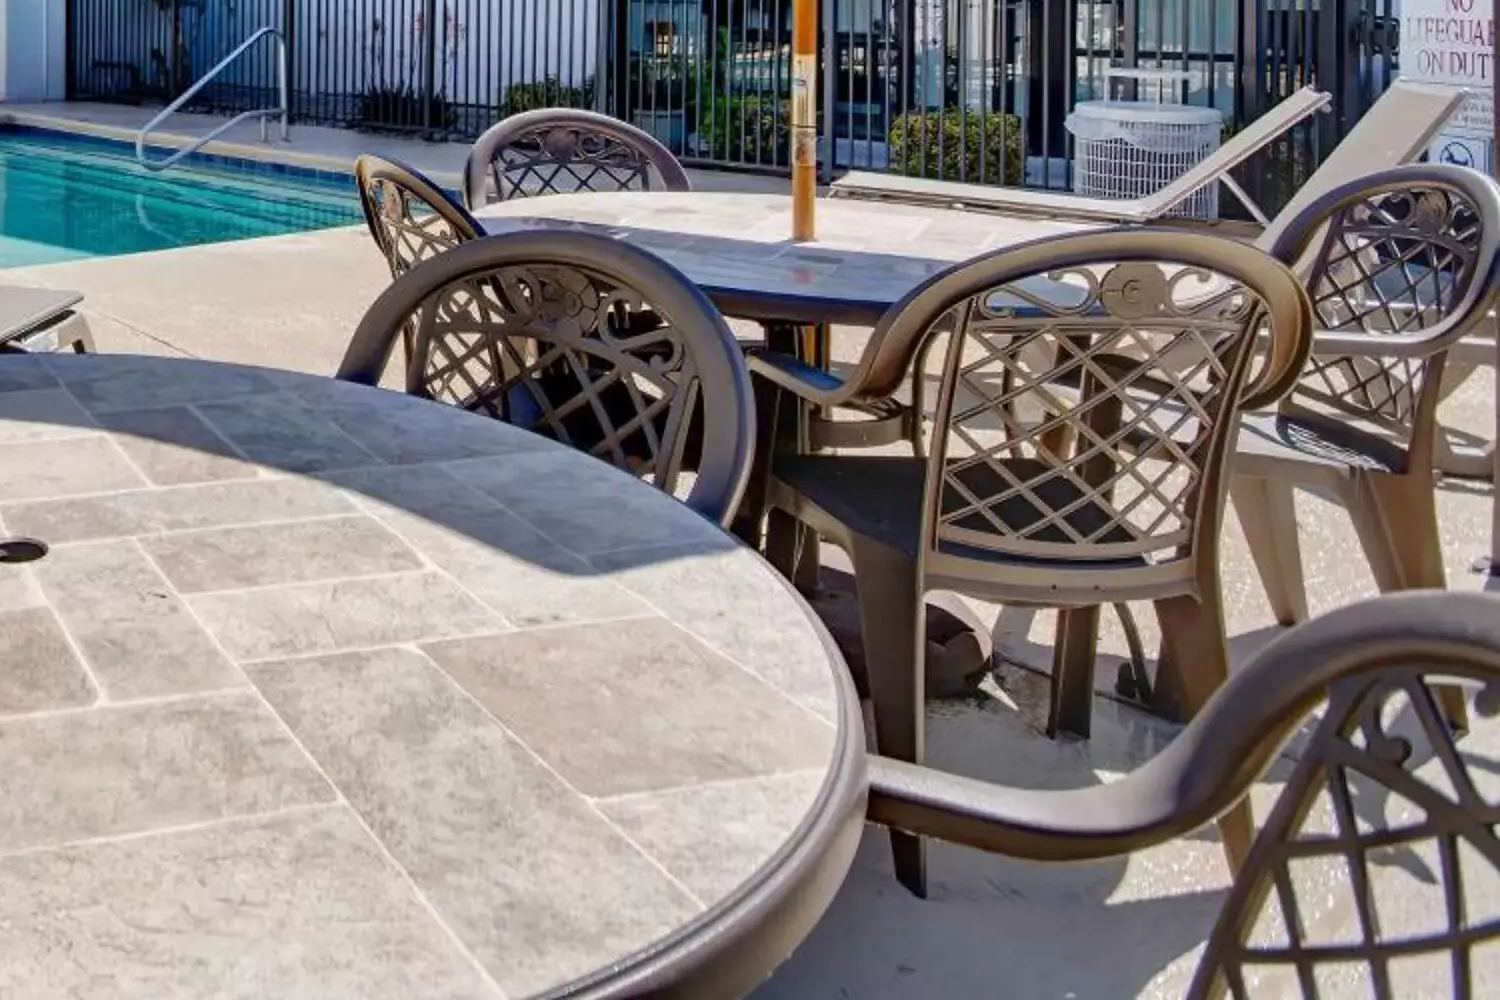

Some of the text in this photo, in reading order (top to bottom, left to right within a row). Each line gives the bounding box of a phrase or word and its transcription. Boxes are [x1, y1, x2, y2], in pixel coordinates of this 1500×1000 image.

[1406, 17, 1493, 46] LIFEGUA
[1418, 49, 1493, 80] ON DUT
